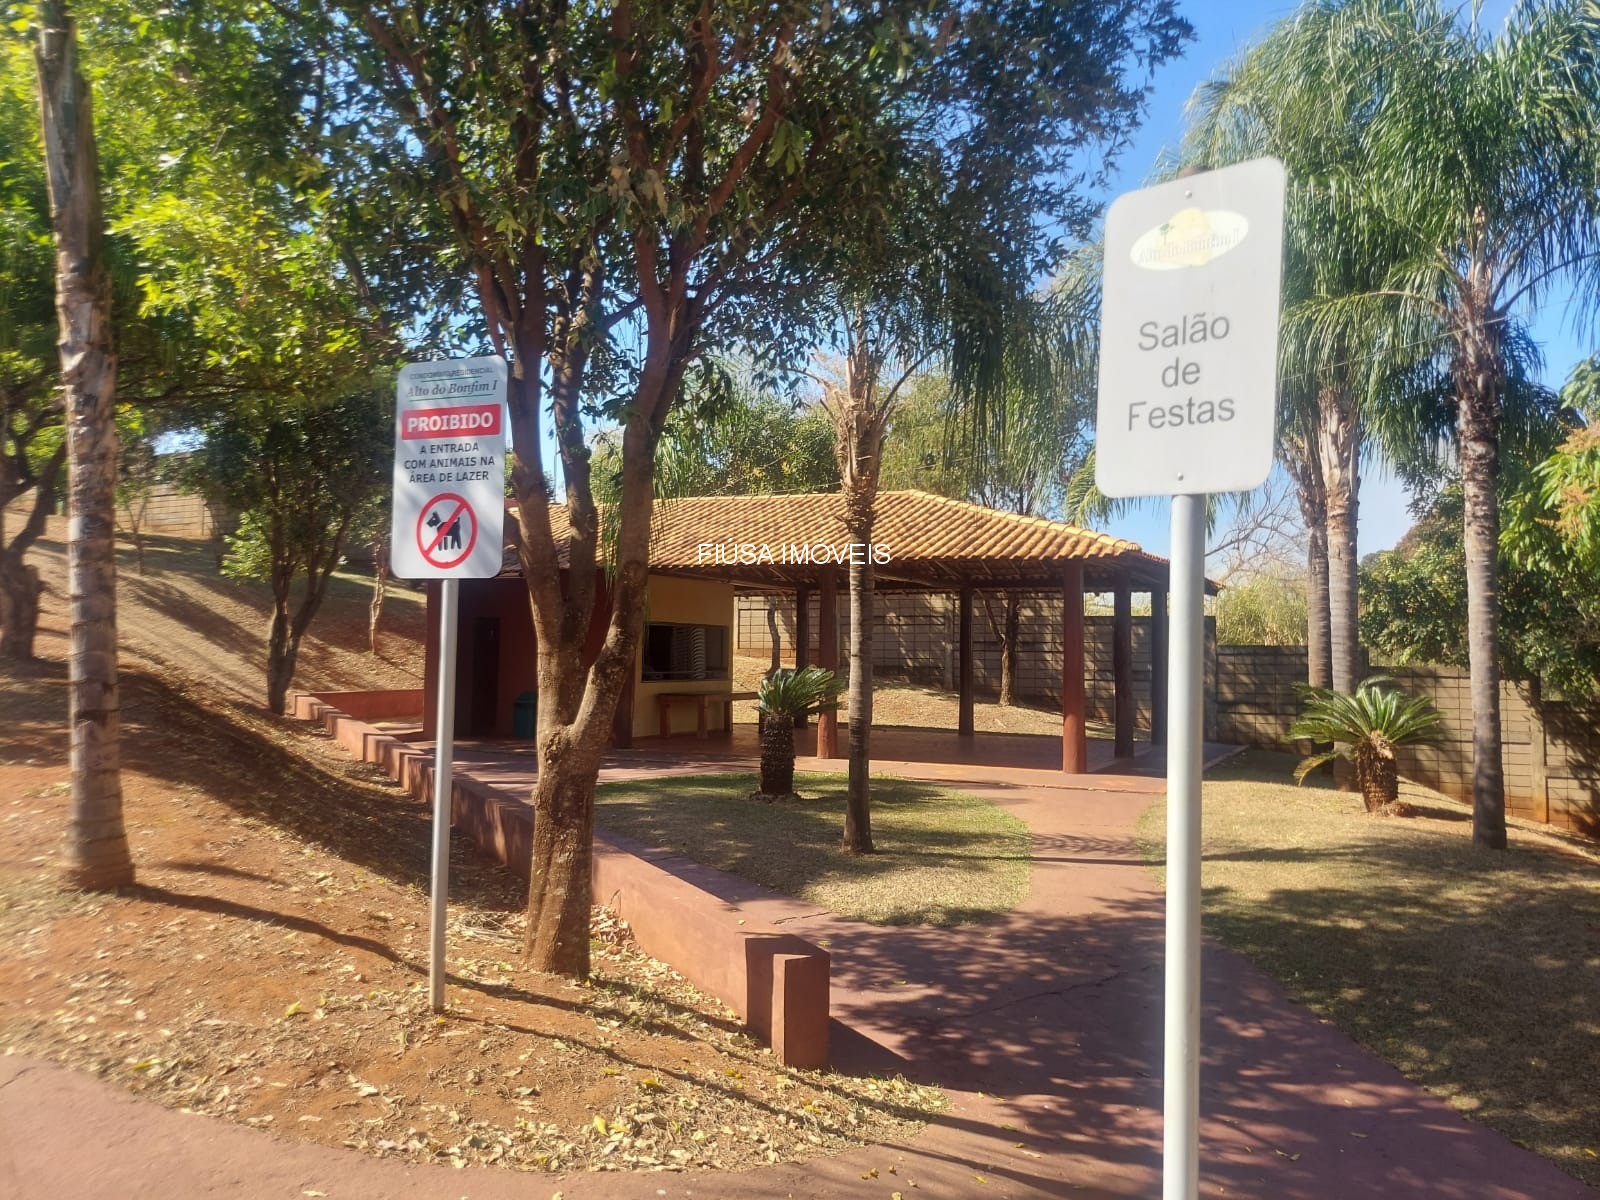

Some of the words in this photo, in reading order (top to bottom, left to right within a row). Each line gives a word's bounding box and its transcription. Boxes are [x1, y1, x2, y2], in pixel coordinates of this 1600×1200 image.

[1138, 312, 1231, 351] Salão
[1161, 356, 1201, 388] de
[408, 385, 429, 397] Alto
[432, 384, 446, 396] do
[448, 381, 489, 396] Bonfim
[492, 380, 498, 391] I
[408, 412, 493, 432] PROIBIDO
[1128, 397, 1235, 431] Festas
[420, 445, 427, 454] A
[430, 442, 479, 453] ENTRADA
[404, 459, 426, 470] COM
[429, 457, 476, 468] ANIMAIS
[480, 456, 495, 466] NA
[409, 470, 435, 483] ÁREA
[439, 472, 453, 482] DE
[456, 470, 489, 482] LAZER
